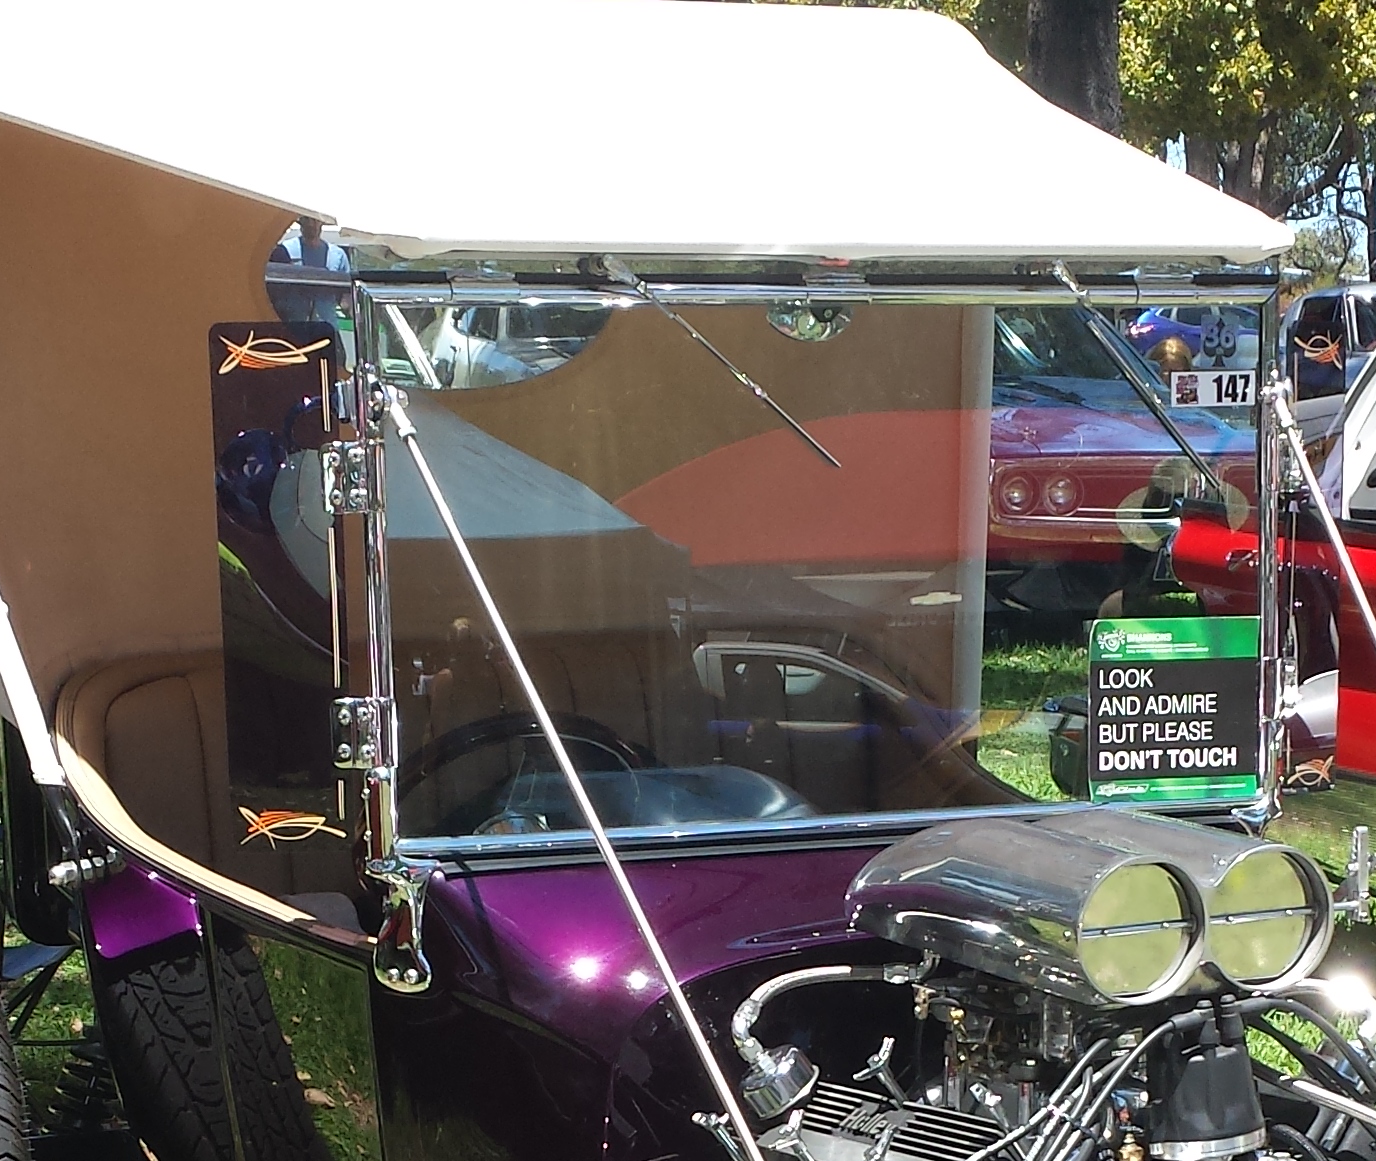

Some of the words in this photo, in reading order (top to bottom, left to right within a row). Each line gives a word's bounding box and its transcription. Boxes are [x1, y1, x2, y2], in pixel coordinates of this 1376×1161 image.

[1212, 374, 1250, 403] 147
[1099, 668, 1154, 689] LOOK
[1098, 696, 1141, 717] AND
[1144, 693, 1218, 715] ADMIRE
[1099, 723, 1139, 744] BUT
[1142, 721, 1214, 743] PLEASE
[1099, 750, 1164, 772] DON'T
[1166, 746, 1238, 769] TOUCH
